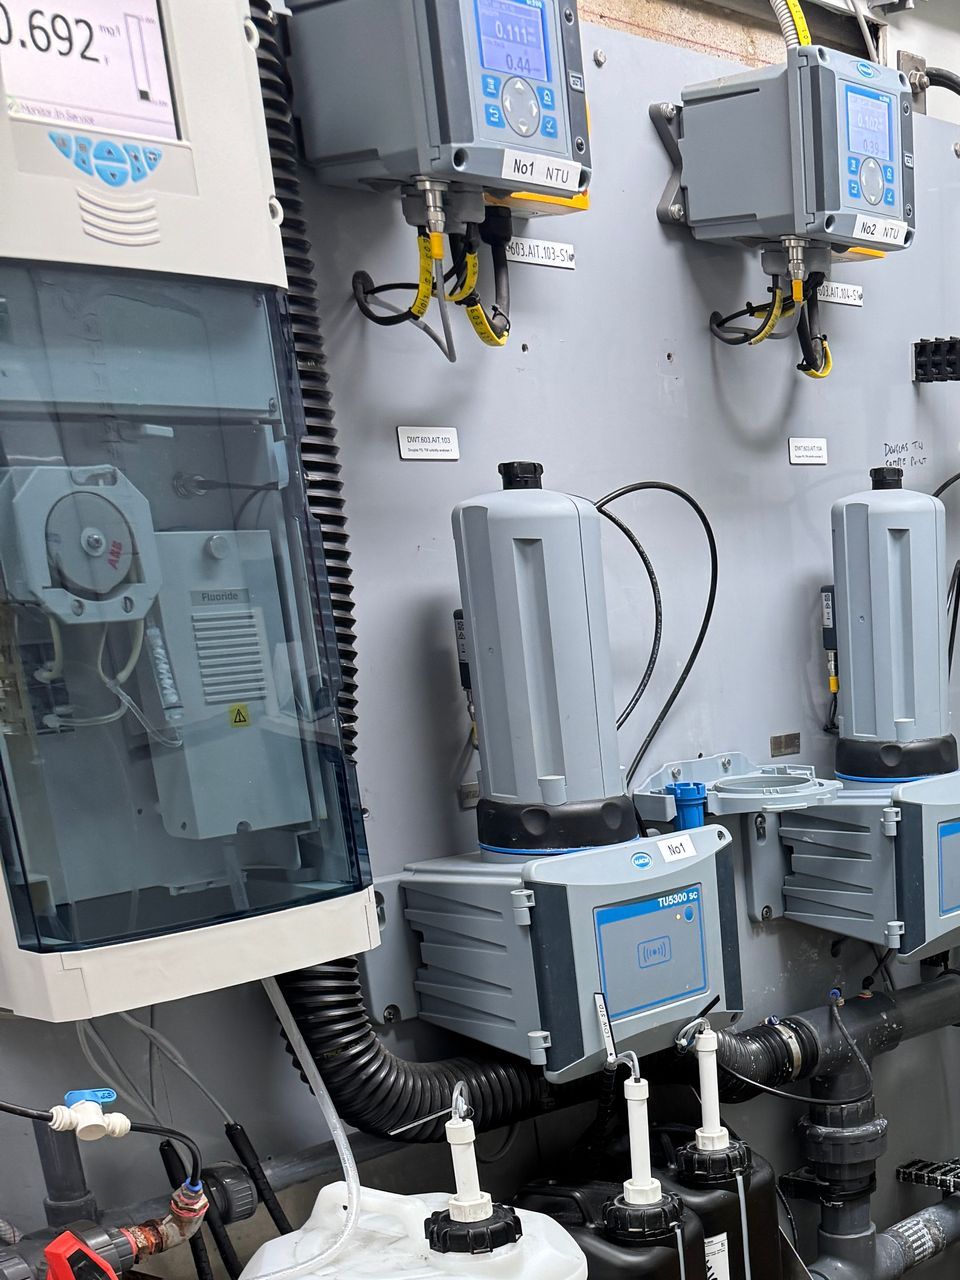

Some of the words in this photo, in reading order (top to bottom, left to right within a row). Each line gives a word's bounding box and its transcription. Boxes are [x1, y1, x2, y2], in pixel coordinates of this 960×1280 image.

[495, 20, 528, 45] 0.111
[506, 54, 531, 73] 0.44
[513, 158, 534, 175] No1
[545, 166, 569, 183] NTU
[860, 221, 876, 236] No2
[883, 227, 900, 240] NTU
[510, 241, 570, 262] 603.AIT.103-S1
[107, 540, 123, 570] ABB
[201, 592, 239, 601] Fluoride
[667, 842, 686, 856] No1
[658, 892, 688, 908] TU5300
[688, 890, 698, 900] sc
